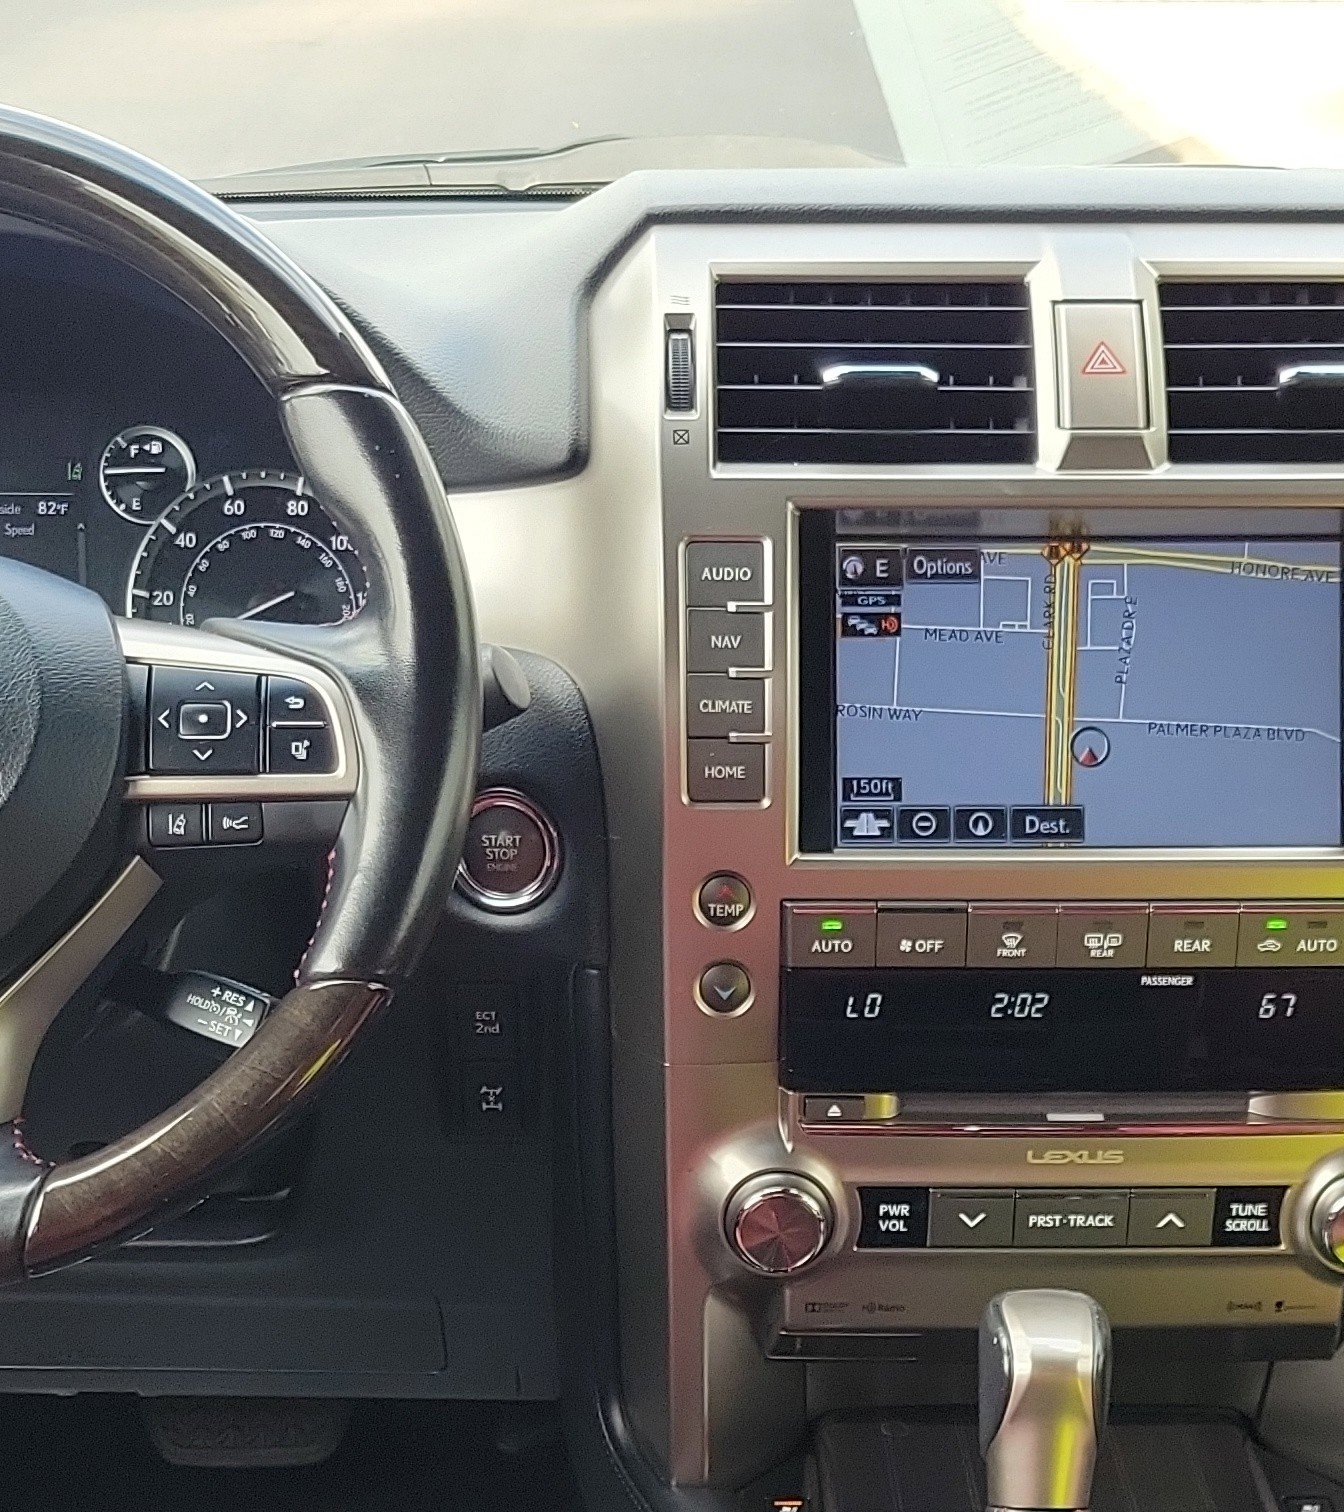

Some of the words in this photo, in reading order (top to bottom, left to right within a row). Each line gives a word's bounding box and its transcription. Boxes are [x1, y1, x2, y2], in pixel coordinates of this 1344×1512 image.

[130, 445, 139, 458] F
[132, 498, 141, 511] E
[223, 500, 245, 516] 60
[287, 500, 309, 516] 80
[5, 523, 35, 537] Speed
[241, 529, 257, 540] 100
[269, 529, 285, 539] 120
[174, 533, 197, 548] 40
[216, 540, 230, 552] 80
[295, 536, 311, 549] 140
[197, 560, 209, 572] 60
[318, 552, 333, 568] 160
[913, 556, 973, 578] Options
[701, 567, 752, 581] AUDIO
[875, 558, 889, 578] E
[1231, 561, 1301, 581] HONORE
[153, 590, 174, 606] 20
[857, 596, 887, 605] GPS
[711, 635, 741, 649] NAV
[924, 627, 969, 642] MEAD
[974, 630, 1004, 644] AVE
[699, 700, 753, 714] CLIMATE
[887, 707, 923, 722] WAY
[1147, 722, 1209, 738] PALMER
[1213, 724, 1263, 740] PLAZA
[1267, 728, 1305, 742] BLVD
[704, 766, 746, 779] HOME
[851, 779, 893, 795] 150ft
[1025, 815, 1070, 834] Dest.
[481, 835, 522, 847] START
[485, 849, 518, 860] STOP
[708, 903, 744, 917] TEMP
[812, 939, 853, 953] AUTO
[914, 939, 944, 952] OFF
[1174, 940, 1211, 953] REAR
[1296, 939, 1338, 952] AUTO
[997, 948, 1027, 958] FRONT
[1090, 949, 1114, 958] REAR
[1140, 975, 1194, 986] PASSENGER
[221, 990, 246, 1007] RES
[990, 993, 1050, 1018] 2:02
[1259, 993, 1298, 1019] 67
[208, 1020, 232, 1037] SET
[475, 1022, 500, 1033] 2nd
[1026, 1150, 1125, 1165] LEXUS
[878, 1204, 910, 1217] PWR
[1229, 1203, 1268, 1217] TUNE
[878, 1220, 908, 1233] VOL
[1224, 1219, 1271, 1233] SCROLL
